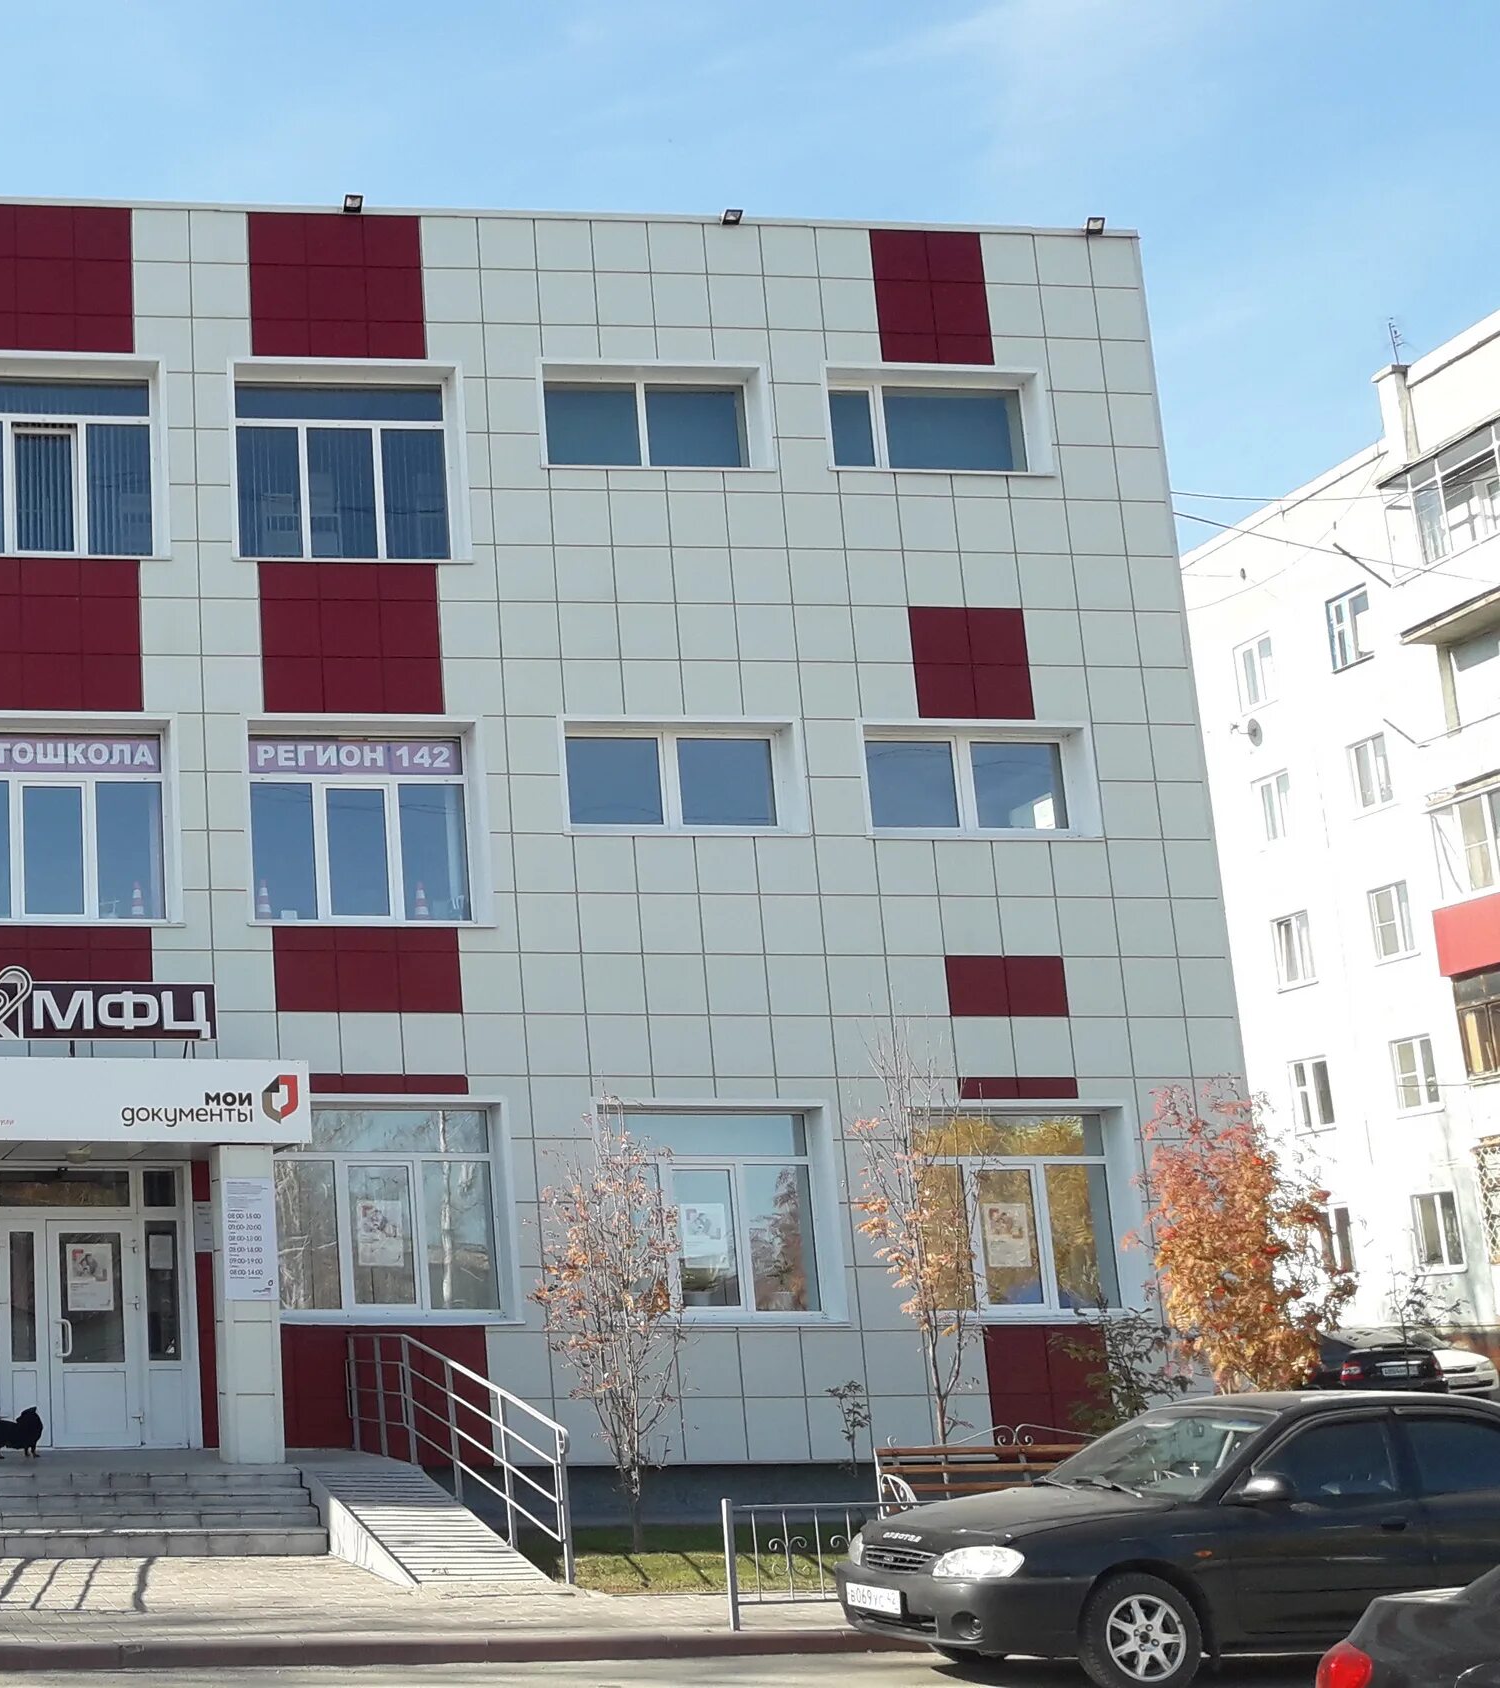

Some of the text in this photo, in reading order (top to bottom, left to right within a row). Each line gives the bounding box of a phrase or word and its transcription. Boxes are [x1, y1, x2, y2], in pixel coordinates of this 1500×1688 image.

[256, 745, 451, 768] РЕГИОН 142
[32, 990, 211, 1039] МФЦ
[205, 1092, 252, 1106] мои
[121, 1107, 254, 1127] документы
